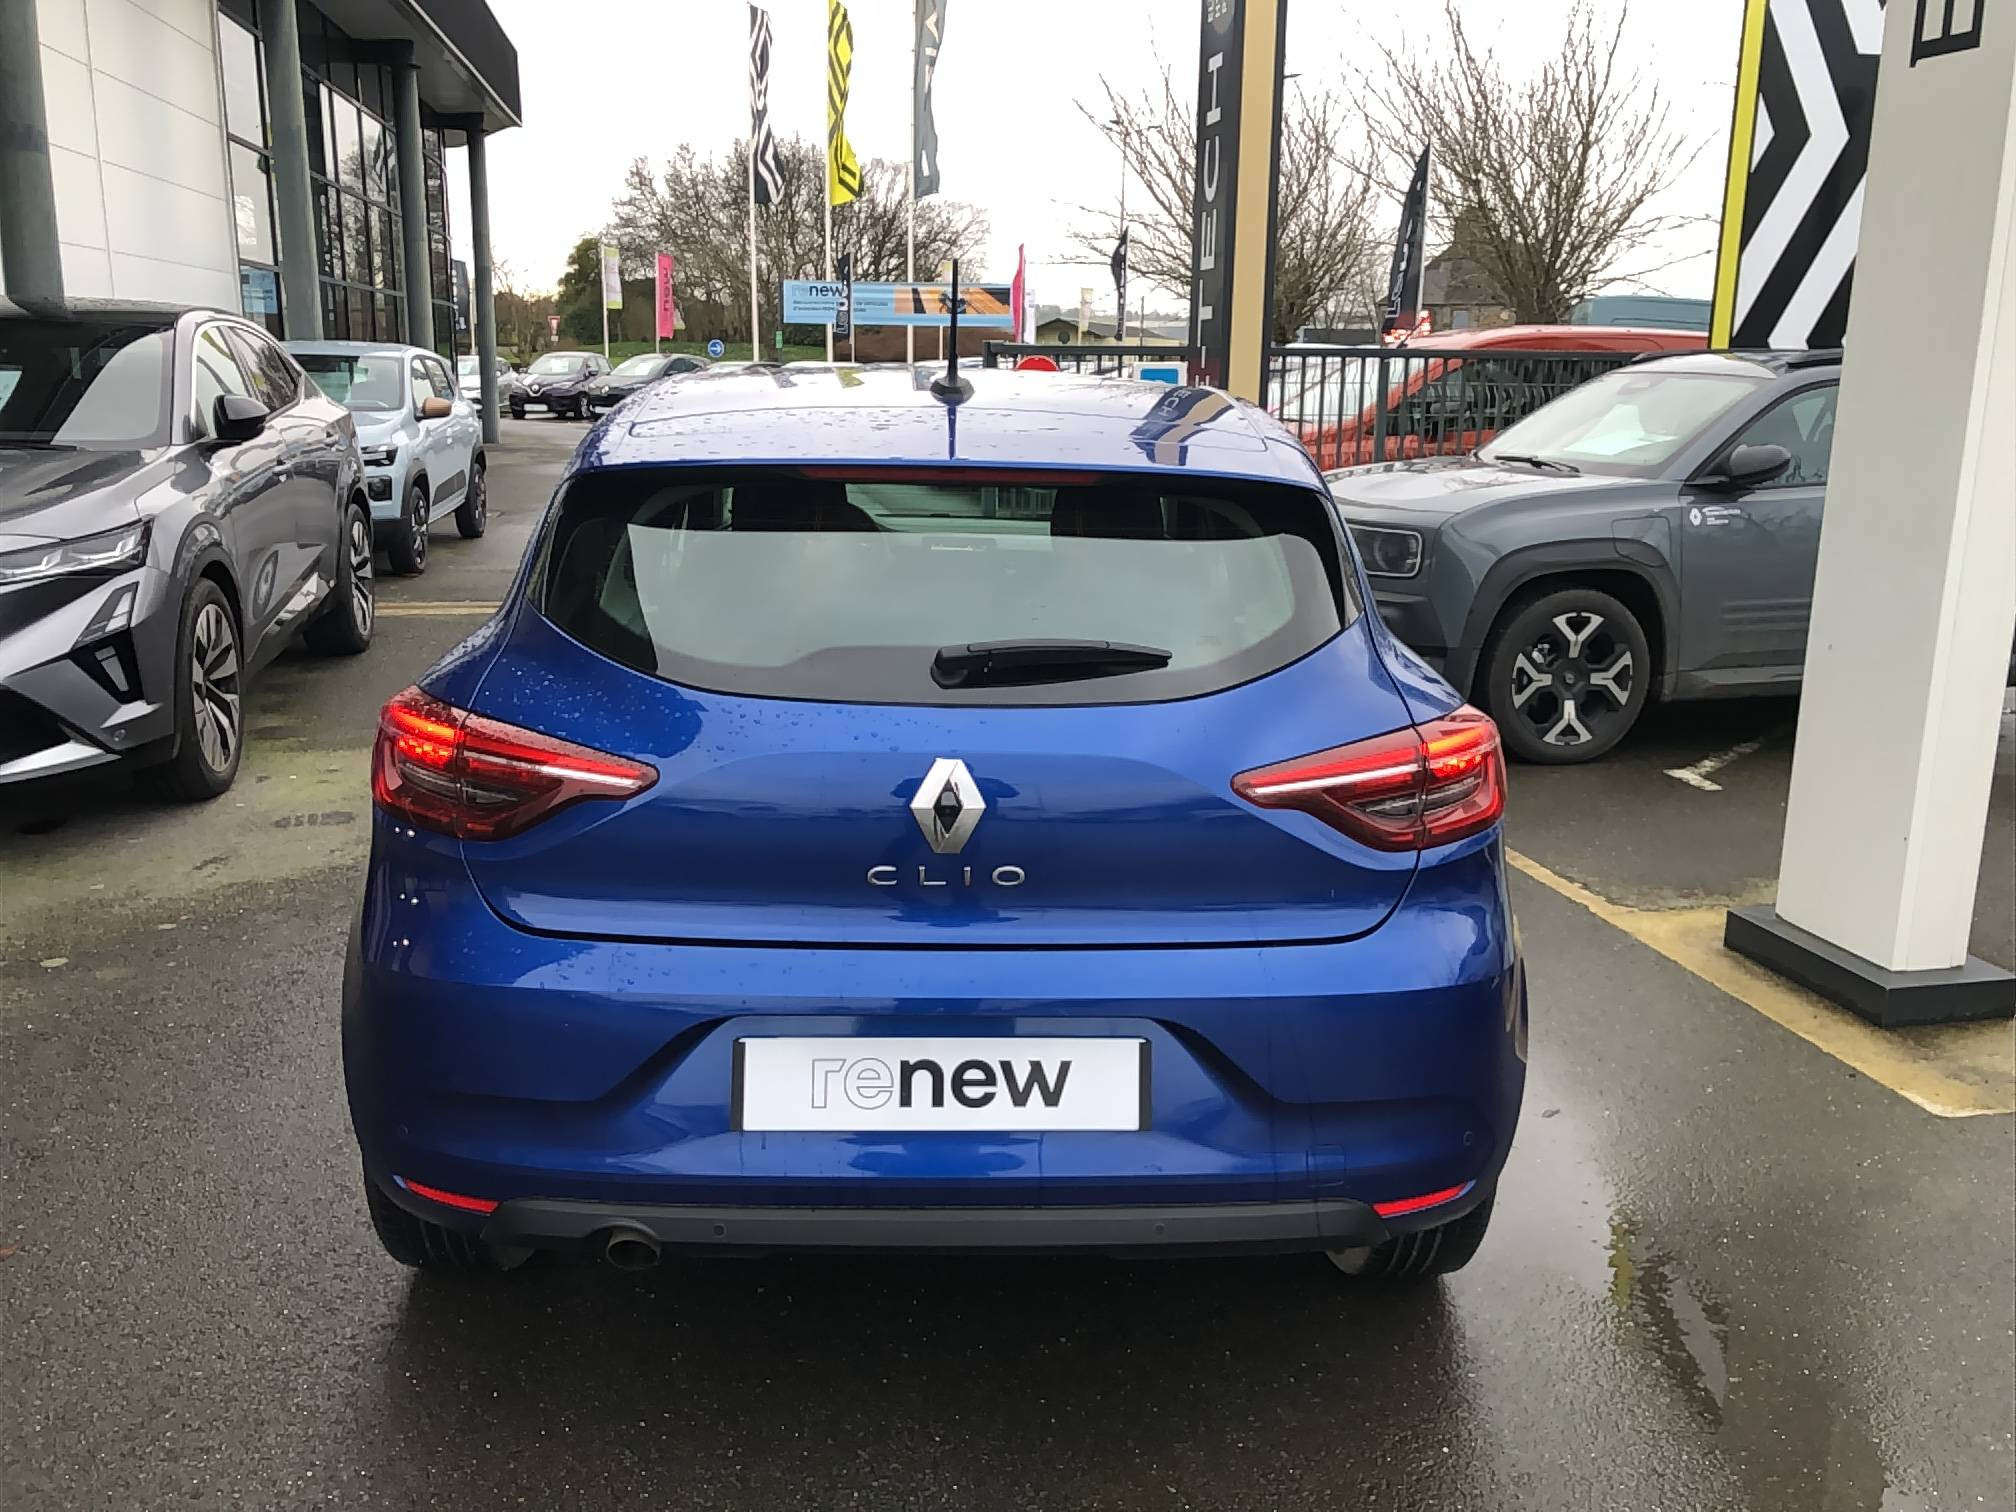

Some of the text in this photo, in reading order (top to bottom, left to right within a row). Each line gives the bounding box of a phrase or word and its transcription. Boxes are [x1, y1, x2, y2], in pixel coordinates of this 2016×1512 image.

[1195, 51, 1223, 387] -TECH
[867, 865, 1025, 886] CLIO
[811, 1057, 1072, 1109] renew
